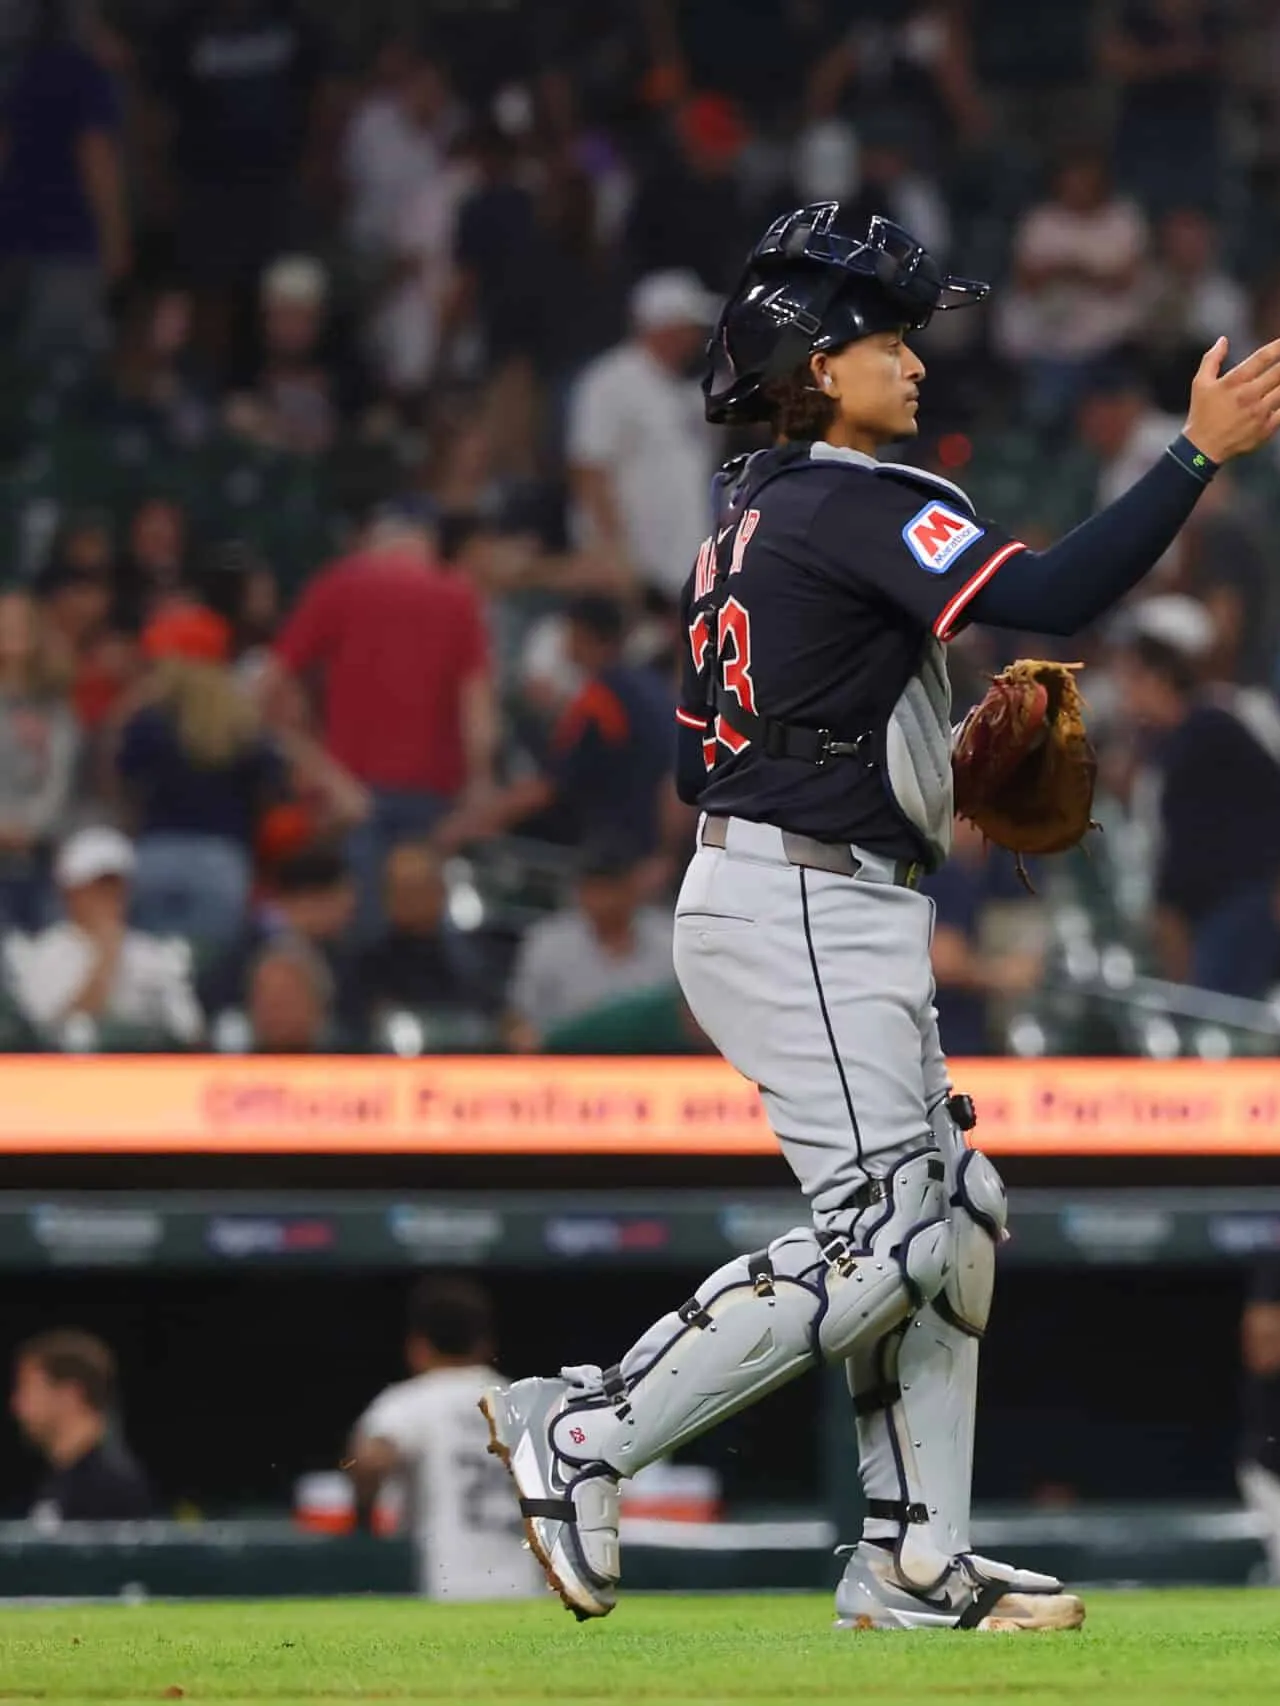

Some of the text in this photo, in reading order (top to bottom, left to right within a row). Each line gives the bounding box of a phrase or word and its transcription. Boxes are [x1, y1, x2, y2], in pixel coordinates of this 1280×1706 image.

[914, 511, 964, 558] M
[410, 1083, 659, 1127] Furniture
[1030, 1083, 1224, 1125] Partner
